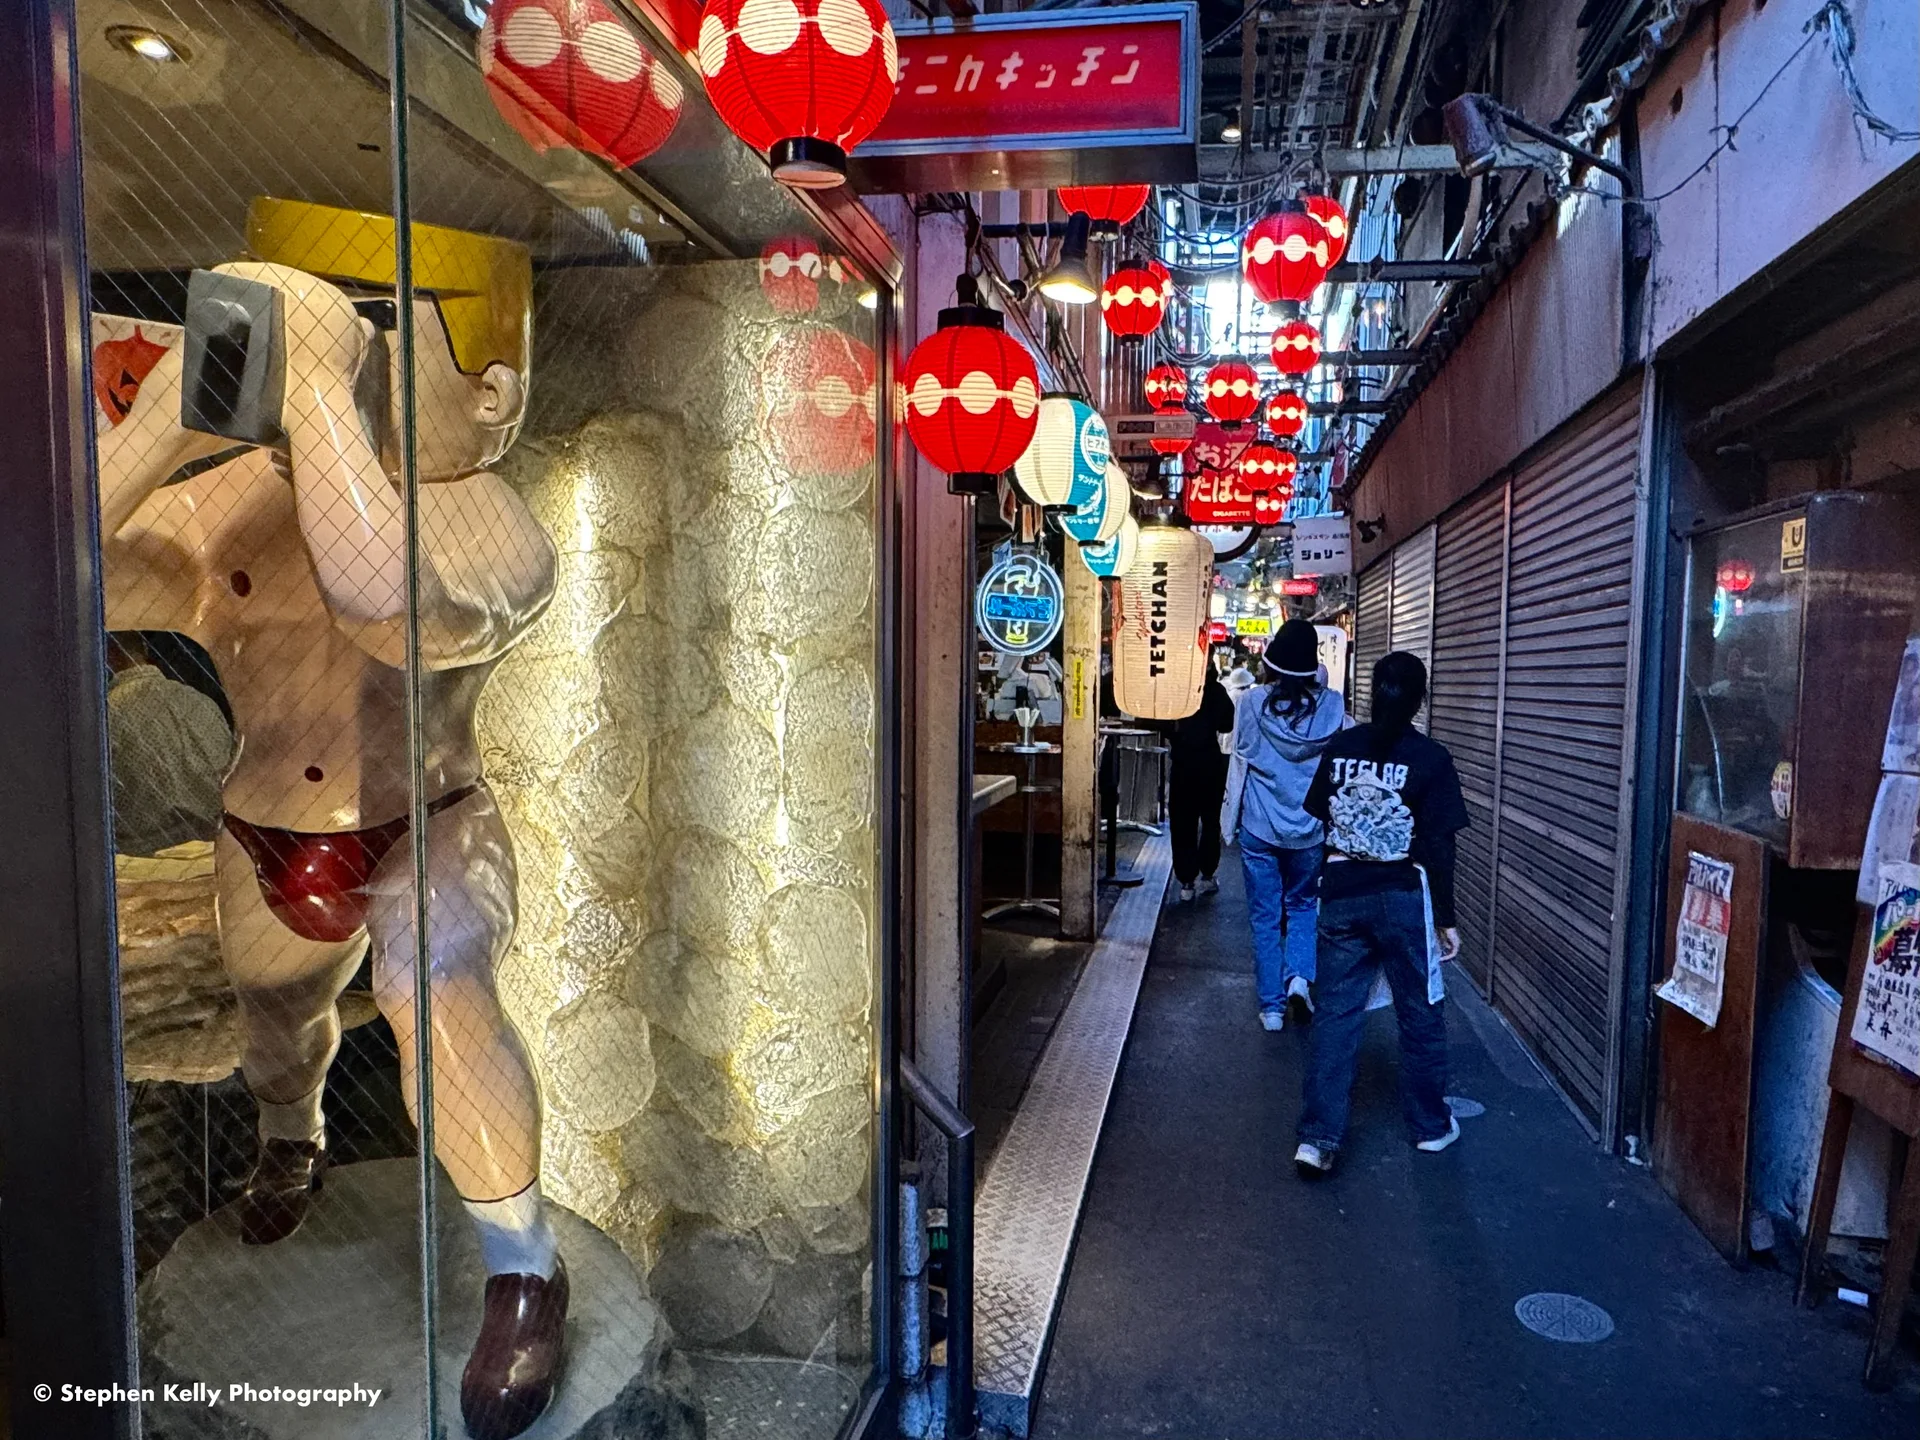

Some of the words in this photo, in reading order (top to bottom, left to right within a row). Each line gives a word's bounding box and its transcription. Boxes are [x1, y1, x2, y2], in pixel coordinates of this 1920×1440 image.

[895, 45, 1140, 95] ニカキッチン
[1190, 473, 1253, 503] たばこ
[1301, 548, 1345, 561] ジョリー
[1150, 561, 1168, 678] TETCHAN
